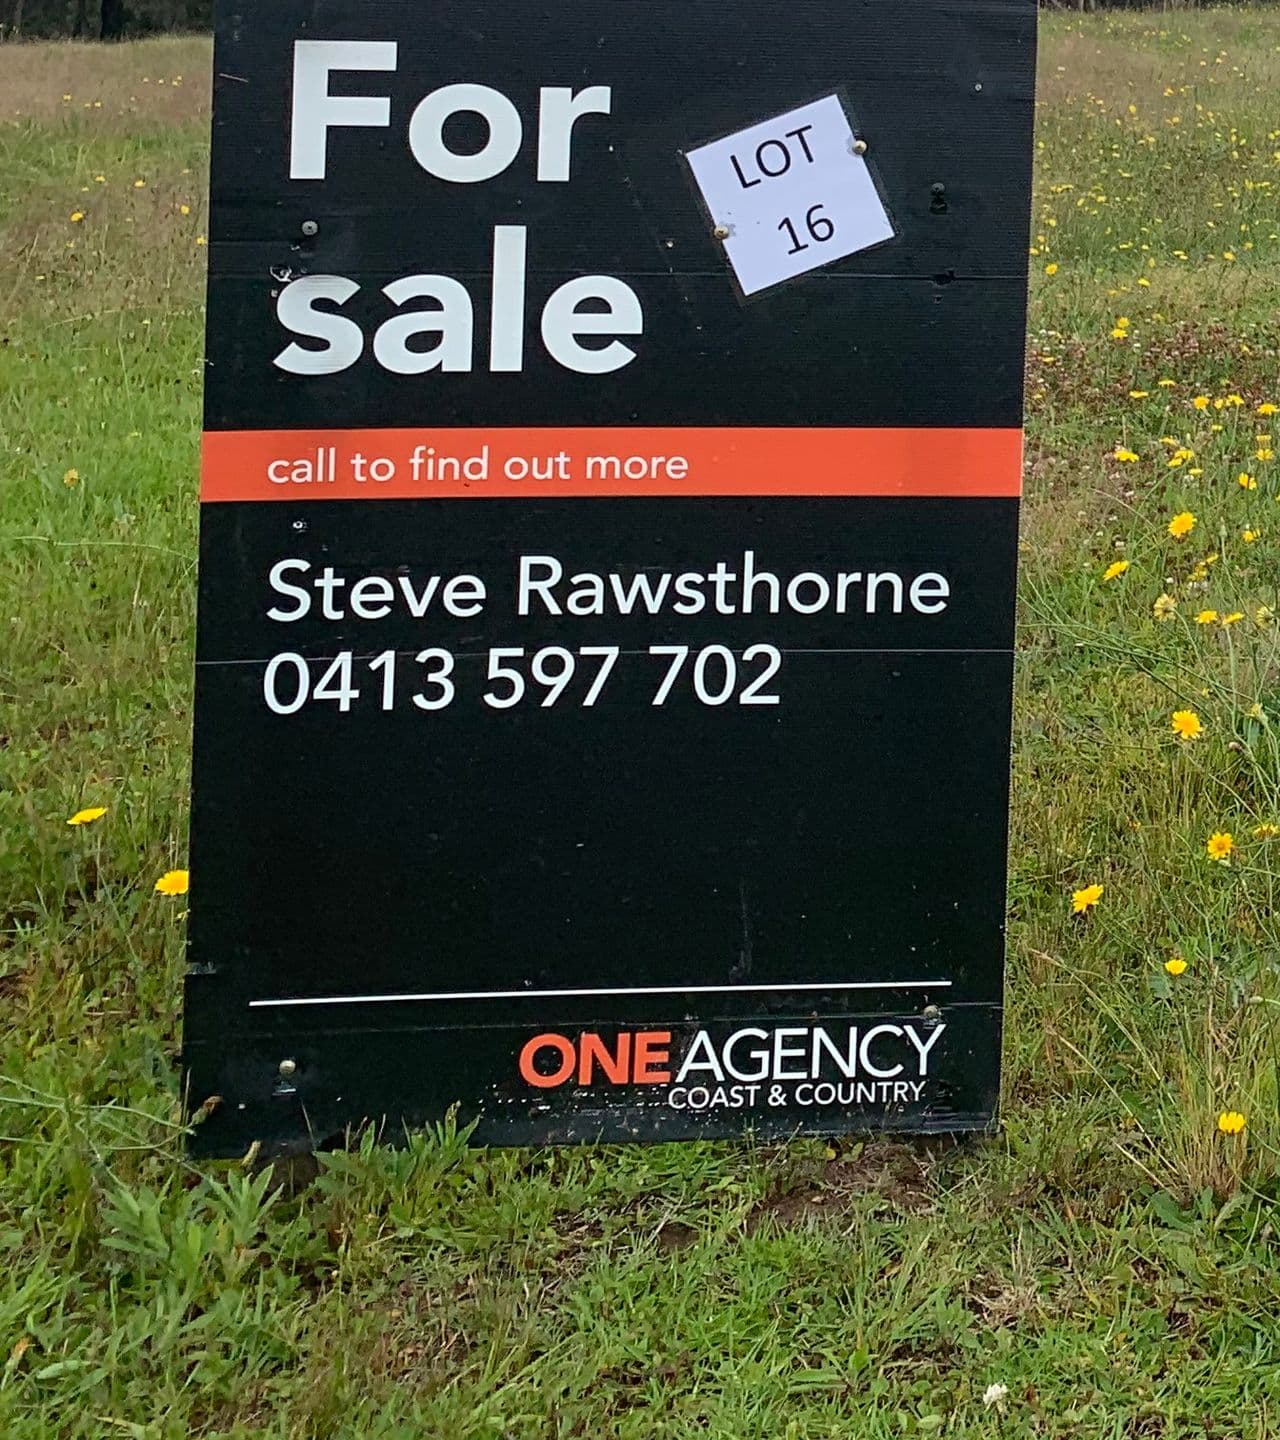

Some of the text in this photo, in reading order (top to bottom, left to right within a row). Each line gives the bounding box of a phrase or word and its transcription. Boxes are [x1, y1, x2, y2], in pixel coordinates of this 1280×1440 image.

[289, 39, 612, 184] For
[730, 124, 814, 189] LOT
[777, 203, 835, 255] 16
[273, 224, 643, 375] sale
[266, 445, 689, 484] call to find out more
[265, 550, 950, 622] Steve Rawsthorne
[262, 643, 782, 715] 0413 597 702
[668, 1079, 926, 1110] COAST & COUNTRY
